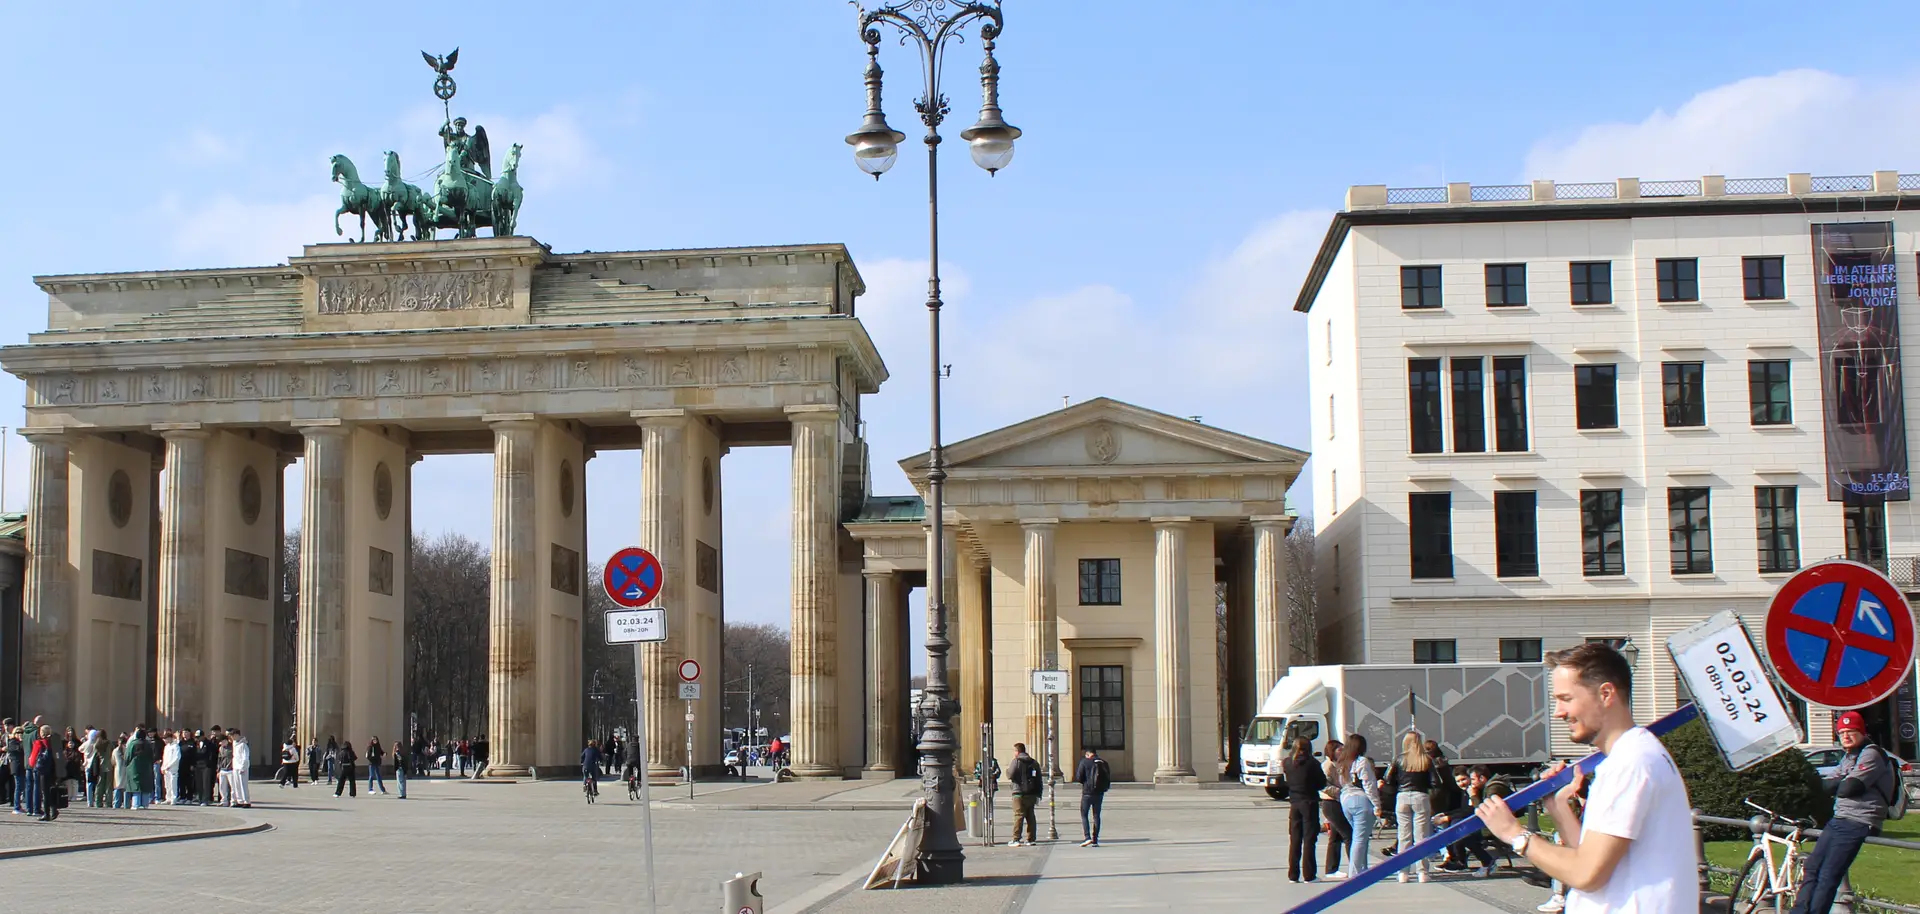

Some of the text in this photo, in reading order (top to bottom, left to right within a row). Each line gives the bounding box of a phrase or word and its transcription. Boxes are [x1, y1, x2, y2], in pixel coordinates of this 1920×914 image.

[1834, 264, 1896, 275] IM ATELIER
[1847, 287, 1897, 298] JORINDE
[1851, 481, 1909, 491] 09.06.2024
[616, 617, 654, 626] 02.03.24
[1716, 642, 1768, 723] 02.03.24
[1705, 665, 1740, 721] 08h-20h
